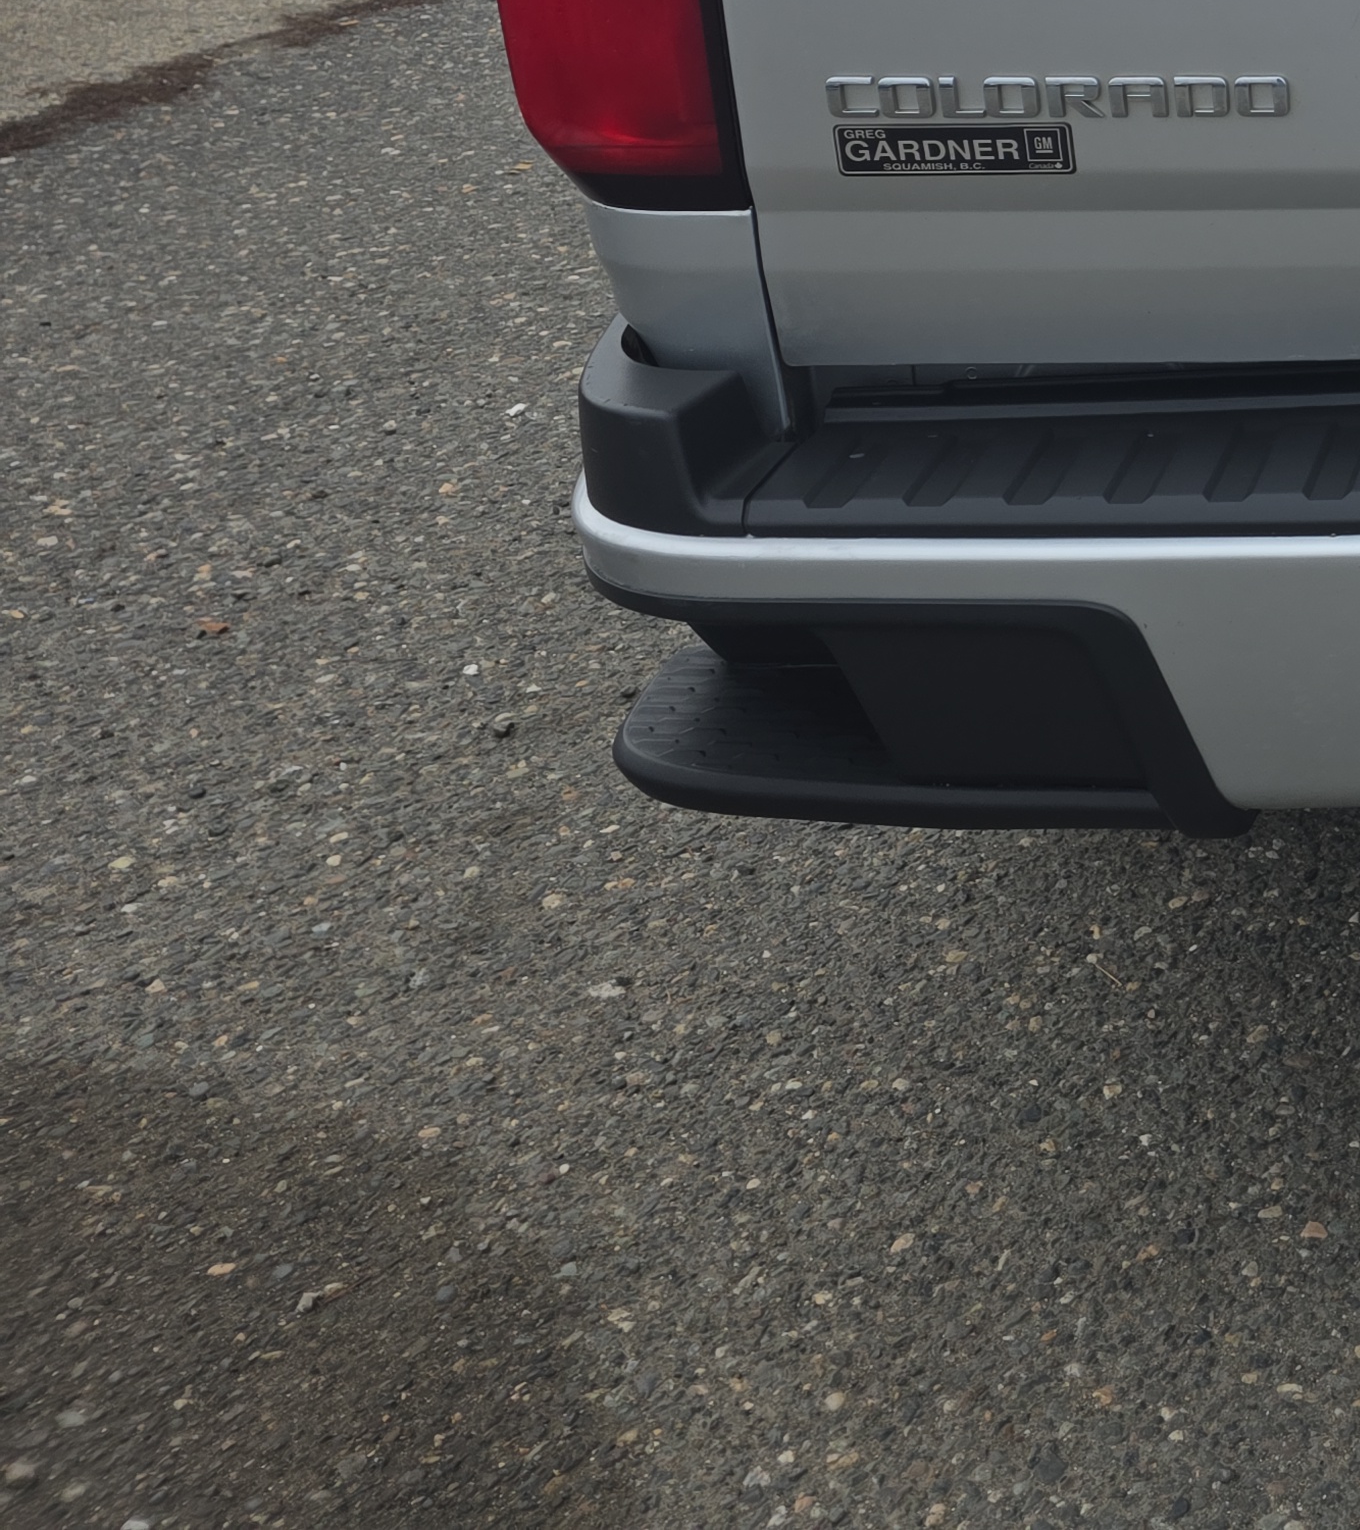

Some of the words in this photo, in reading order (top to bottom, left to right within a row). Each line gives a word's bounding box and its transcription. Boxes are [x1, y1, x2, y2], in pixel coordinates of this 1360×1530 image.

[825, 74, 1291, 118] COLORADO
[843, 129, 887, 140] GREG
[1033, 136, 1054, 151] GM
[844, 139, 1020, 162] GARDNER
[883, 162, 958, 171] SQUAMISH,
[960, 162, 986, 171] B.C.
[1028, 162, 1055, 170] Canada
